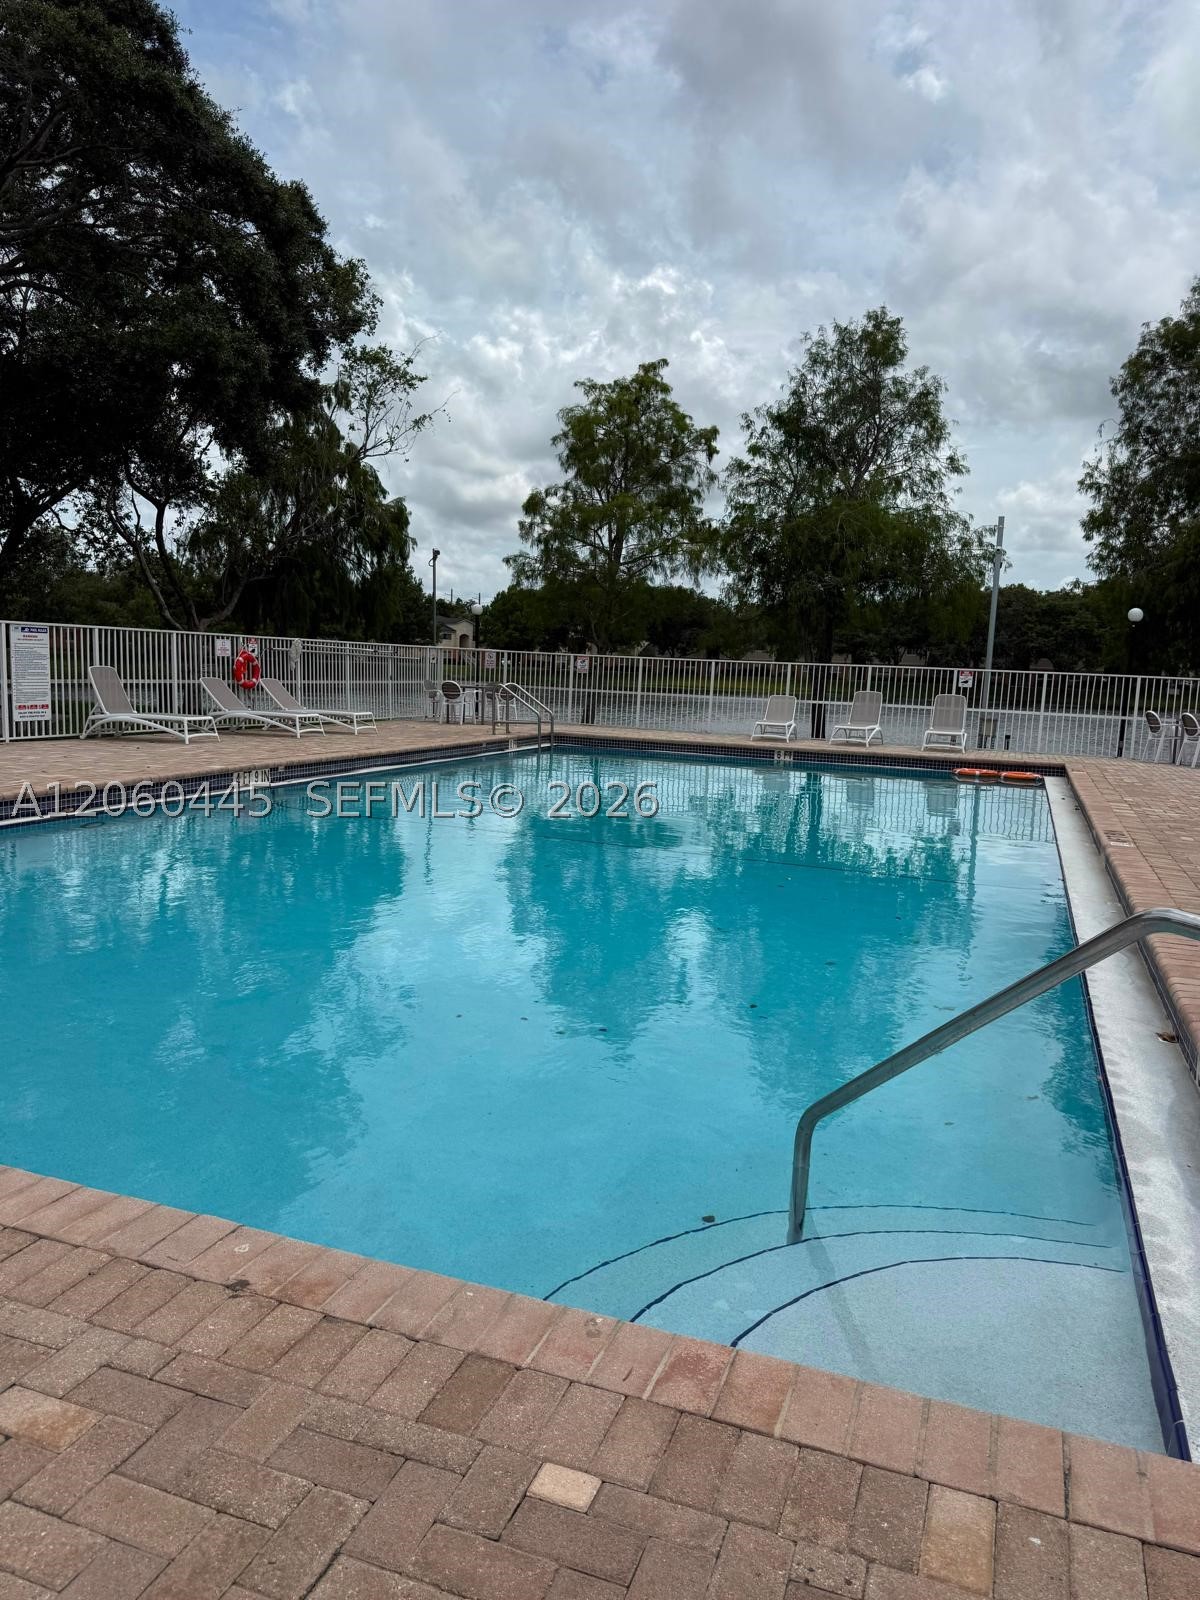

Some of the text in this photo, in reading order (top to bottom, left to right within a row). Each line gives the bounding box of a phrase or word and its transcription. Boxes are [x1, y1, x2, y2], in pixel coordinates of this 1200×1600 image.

[243, 771, 252, 784] FT
[254, 770, 259, 782] 9
[261, 770, 269, 782] IN
